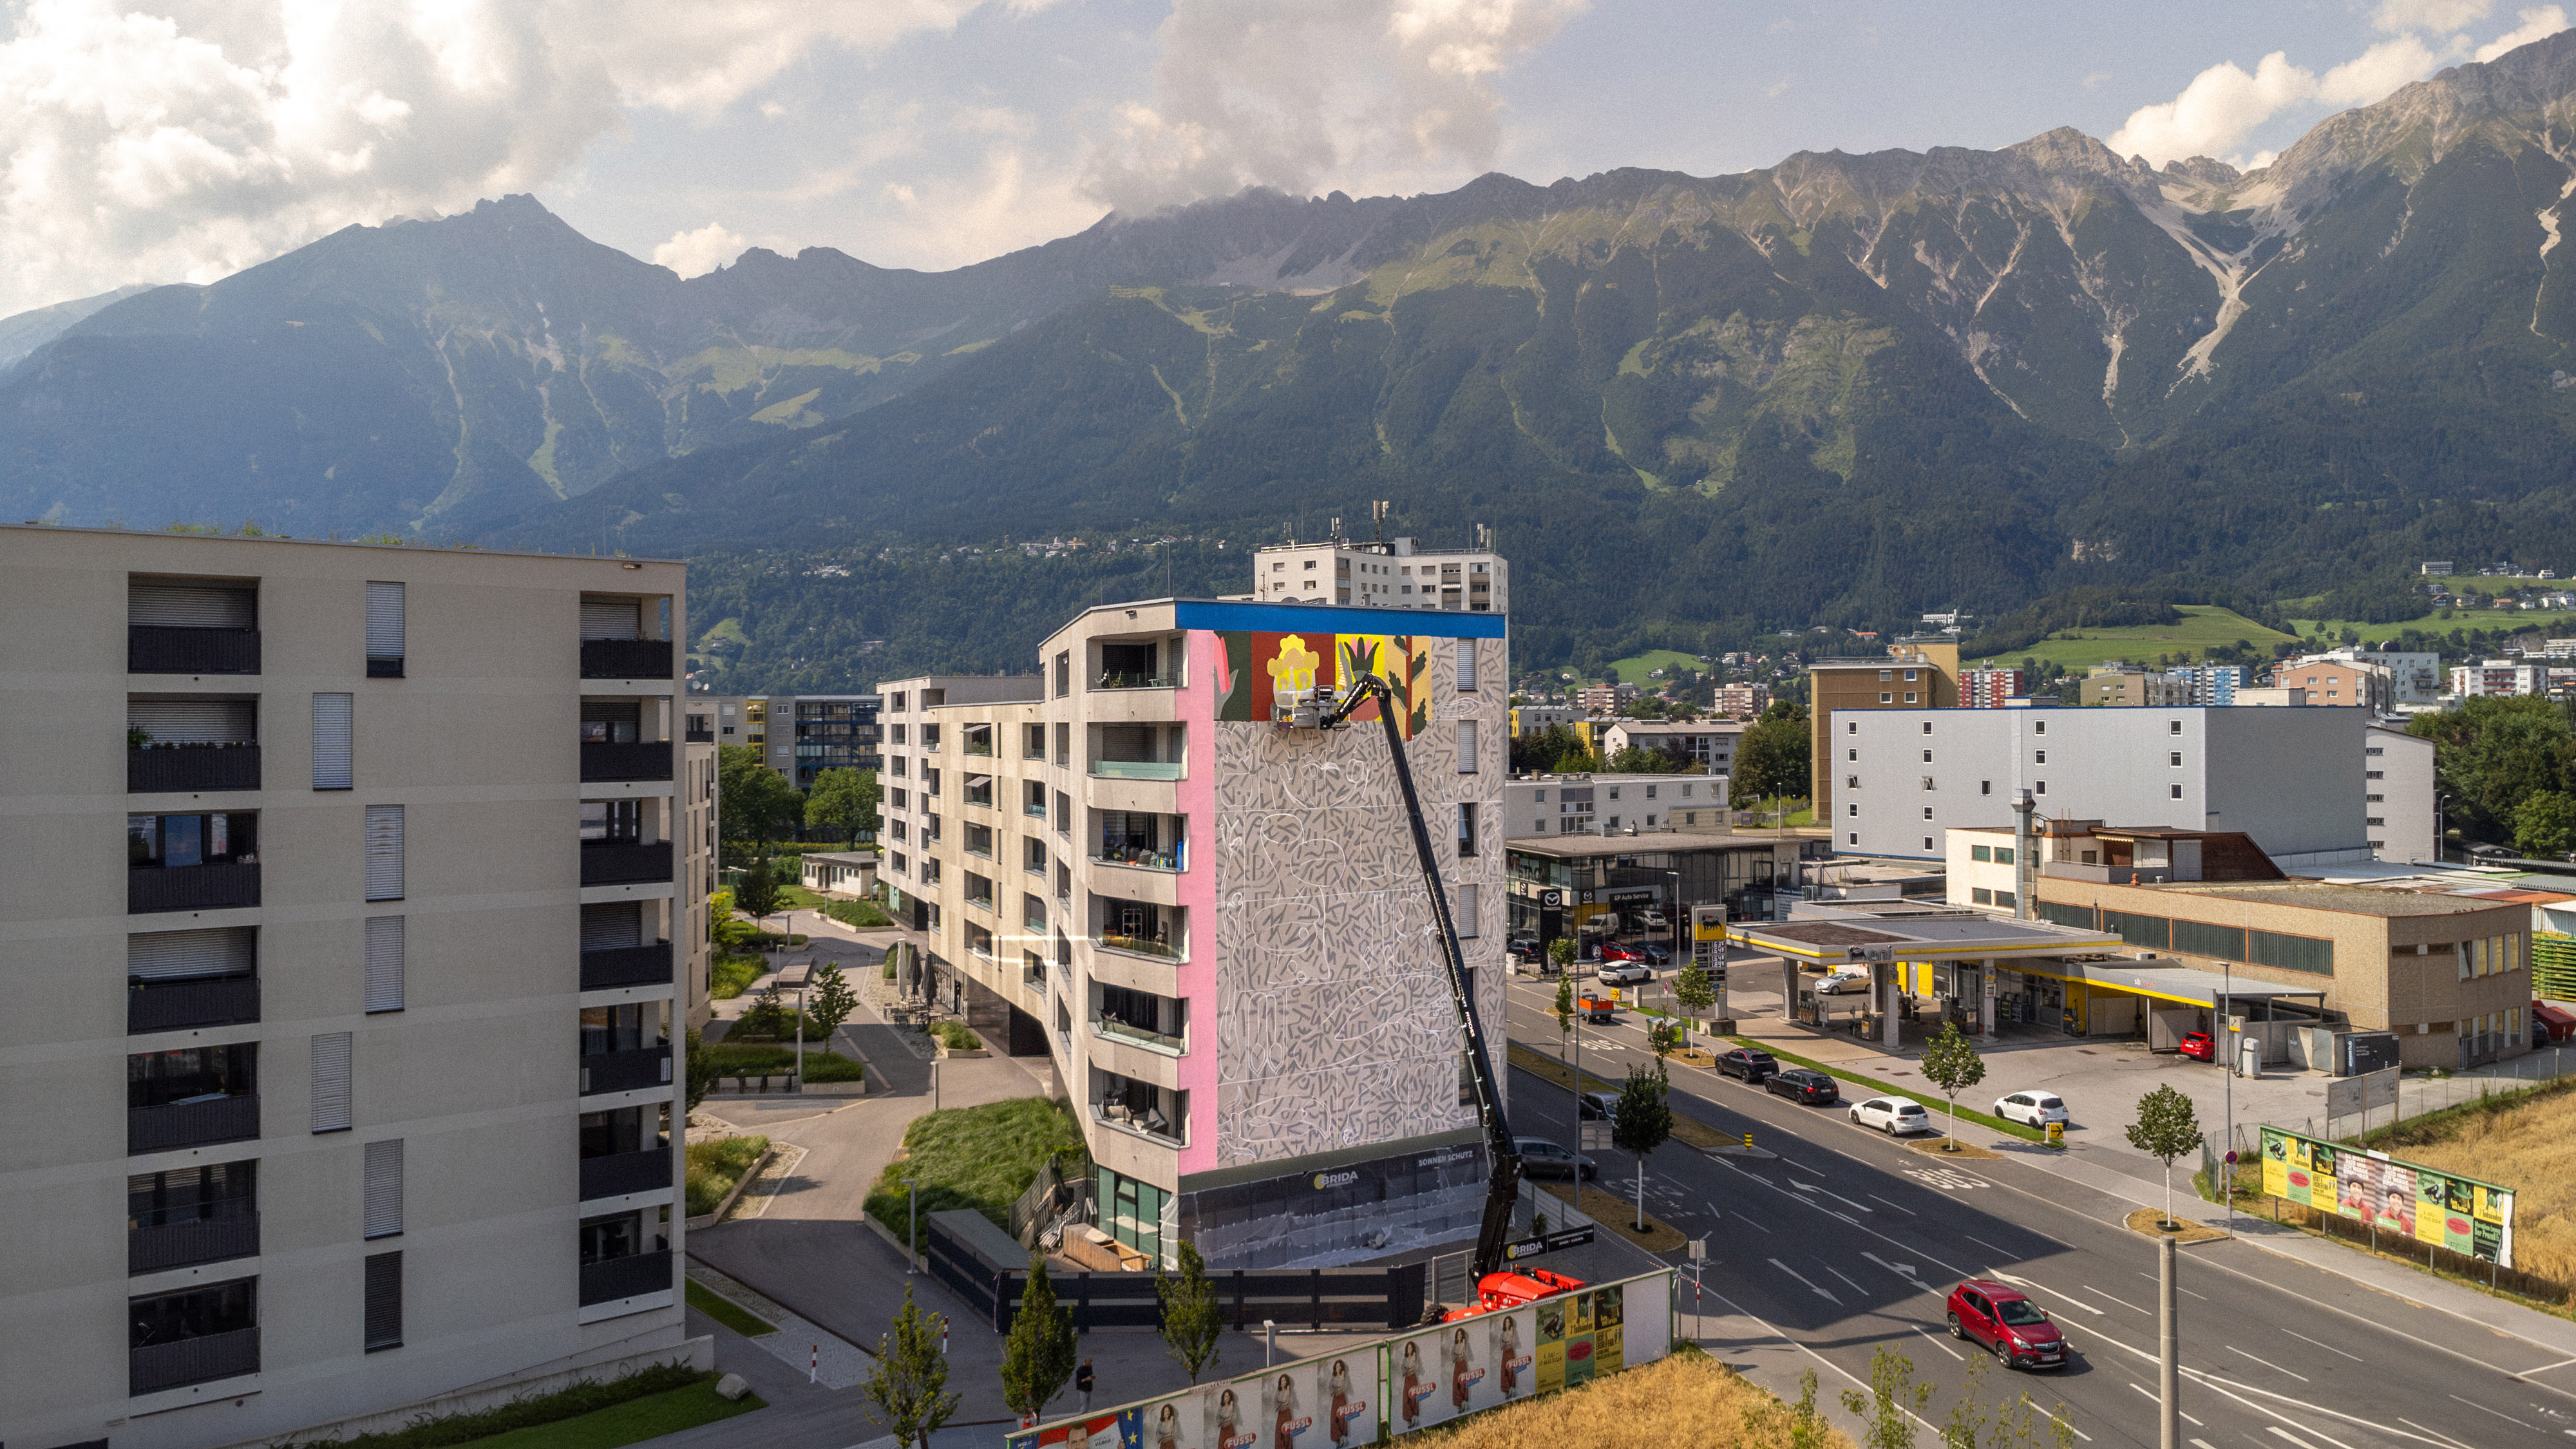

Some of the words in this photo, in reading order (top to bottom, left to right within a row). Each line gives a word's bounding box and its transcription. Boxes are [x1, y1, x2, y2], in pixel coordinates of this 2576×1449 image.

[1868, 945, 1892, 961] eni
[1447, 1150, 1473, 1162] SCHUTZ
[1321, 1171, 1358, 1185] BRIDA
[1900, 1168, 1992, 1189] BUS
[1513, 1241, 1543, 1254] BRIDA
[1461, 1369, 1483, 1382] FUSSL
[1284, 1417, 1311, 1432] FUSSL
[1227, 1434, 1255, 1448] FUSSL
